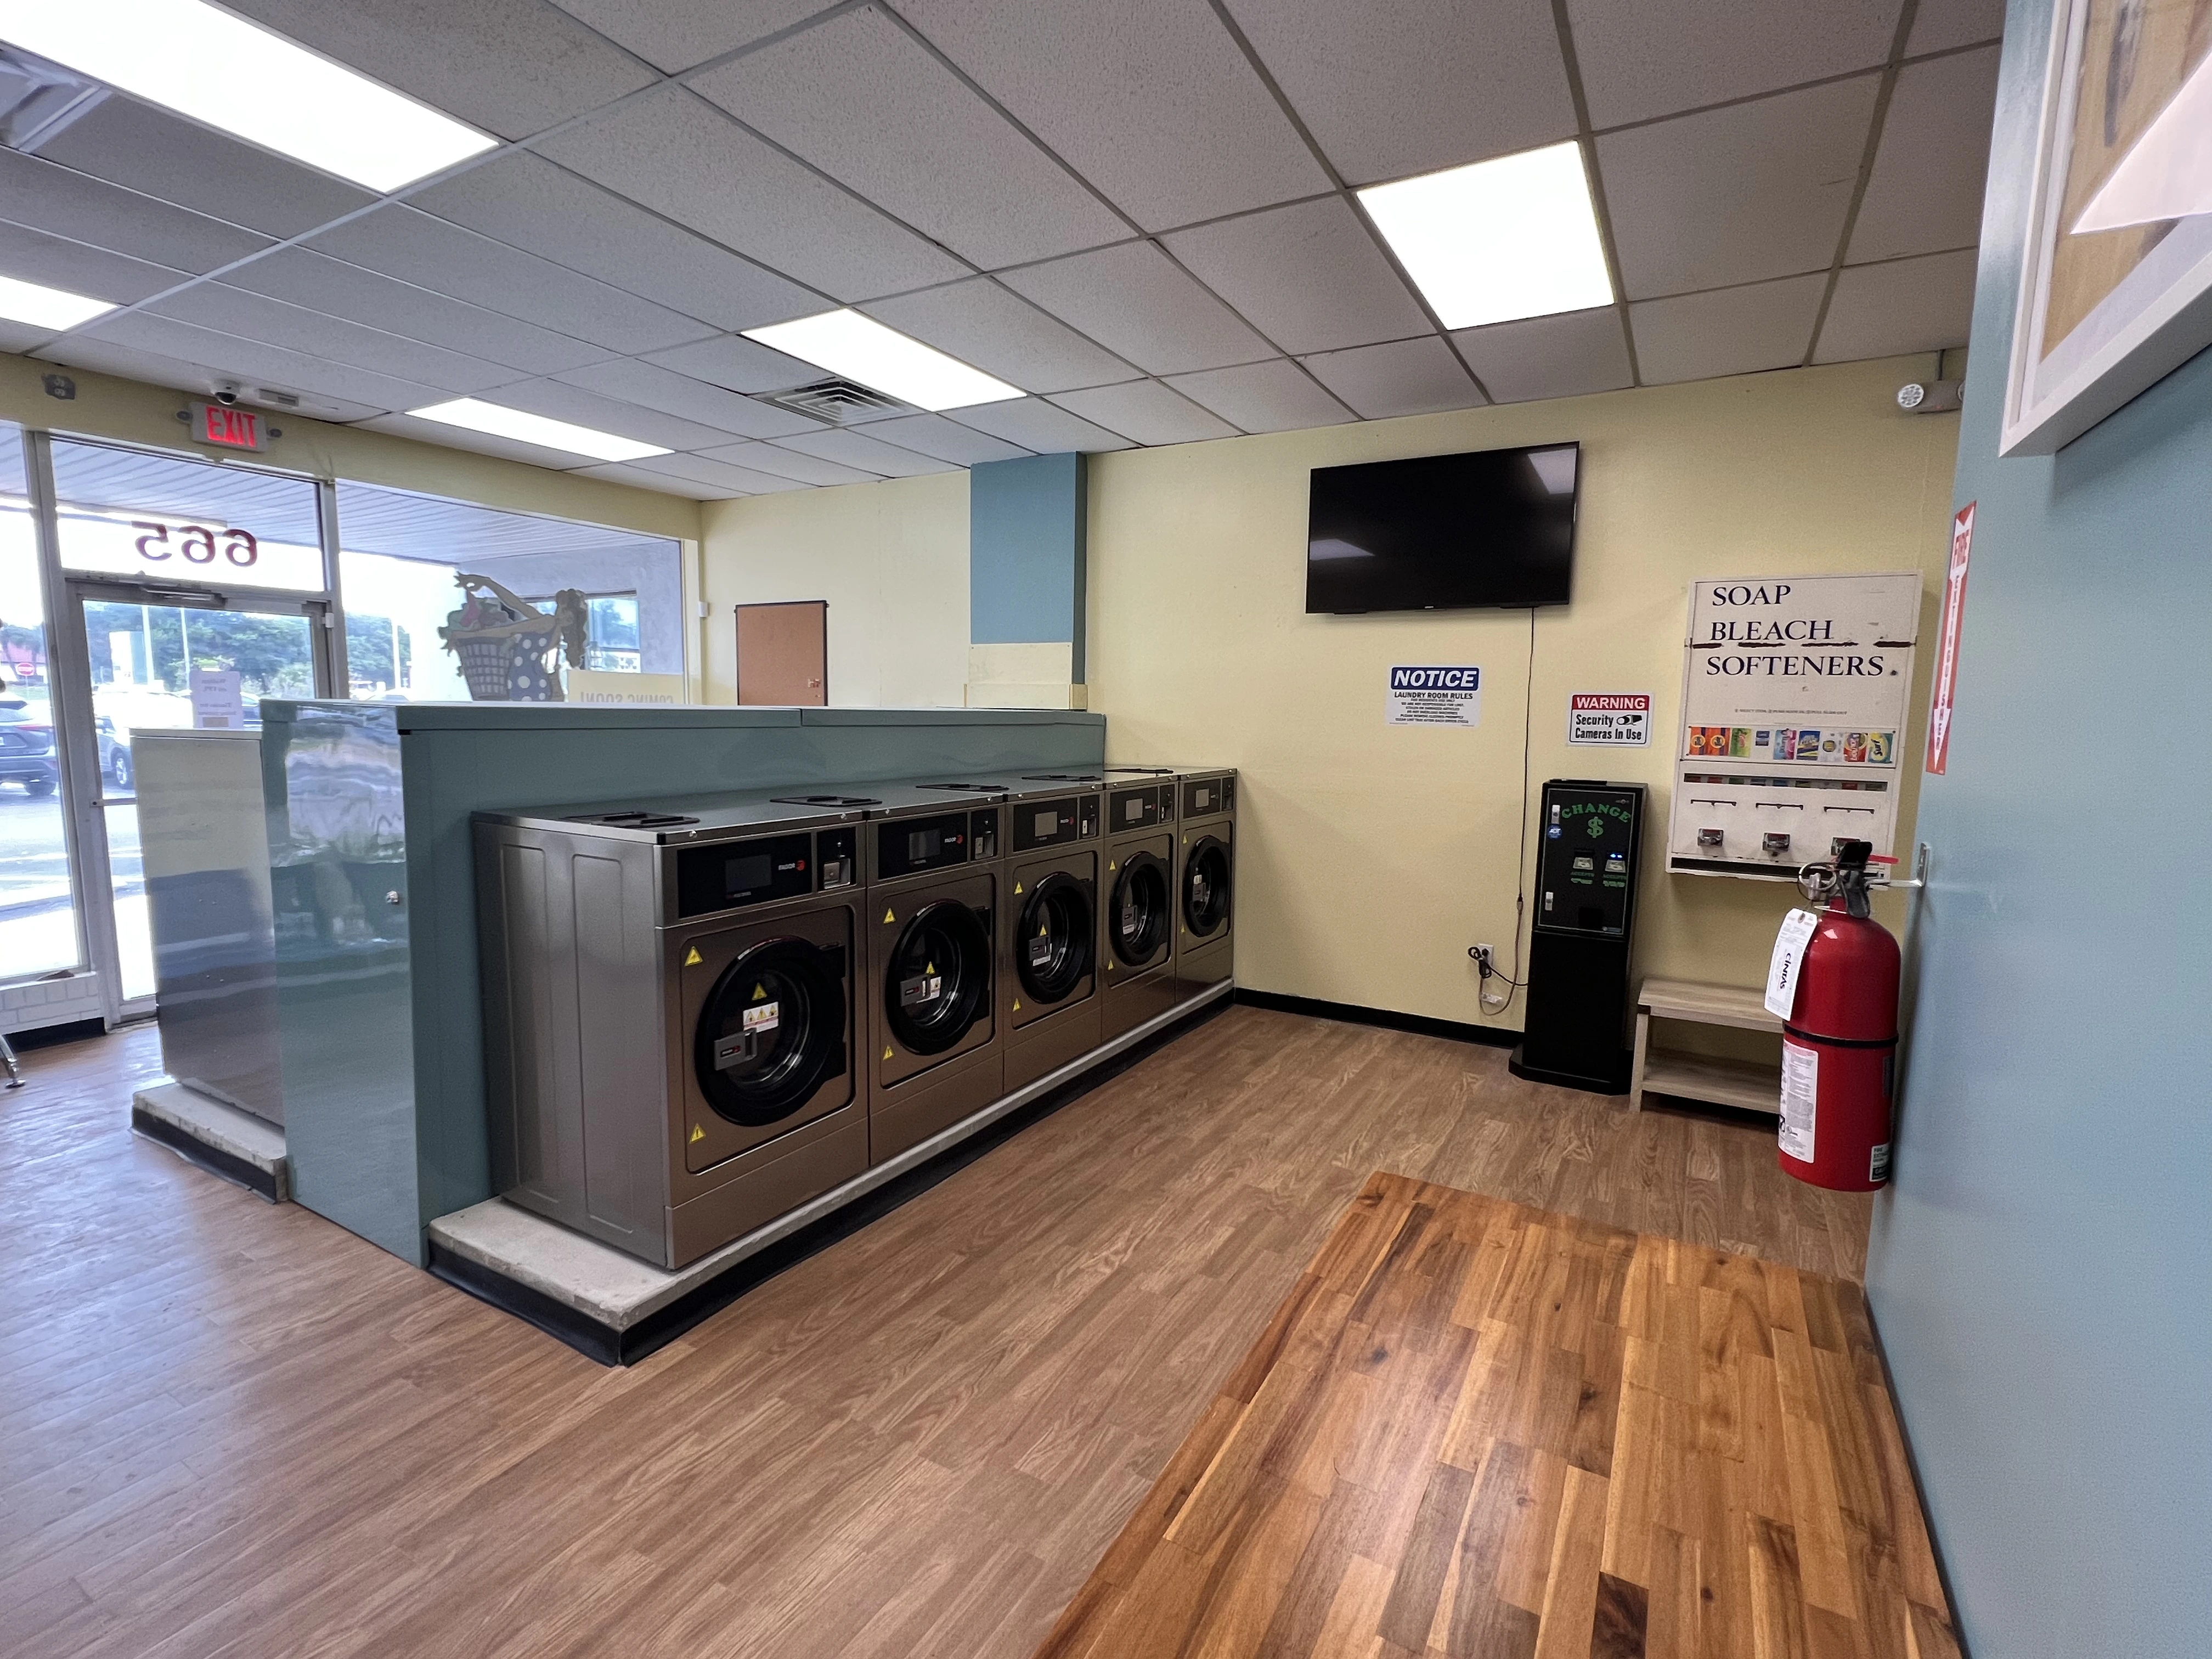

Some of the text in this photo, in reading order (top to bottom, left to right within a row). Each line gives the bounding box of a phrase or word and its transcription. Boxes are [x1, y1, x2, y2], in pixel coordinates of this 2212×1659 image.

[206, 407, 256, 447] EXIT
[1712, 585, 1791, 606] SOAP
[1710, 620, 1833, 641] BLEACH
[1706, 656, 1884, 676] SOFTENERS
[1393, 670, 1477, 687] NOTICE
[1577, 697, 1646, 709] WARNING
[1576, 714, 1614, 727] Security
[1575, 727, 1642, 740] Cameras In Use
[1561, 803, 1632, 823] CHANGE
[1587, 816, 1604, 838] $
[1780, 952, 1792, 990] CINTAS
